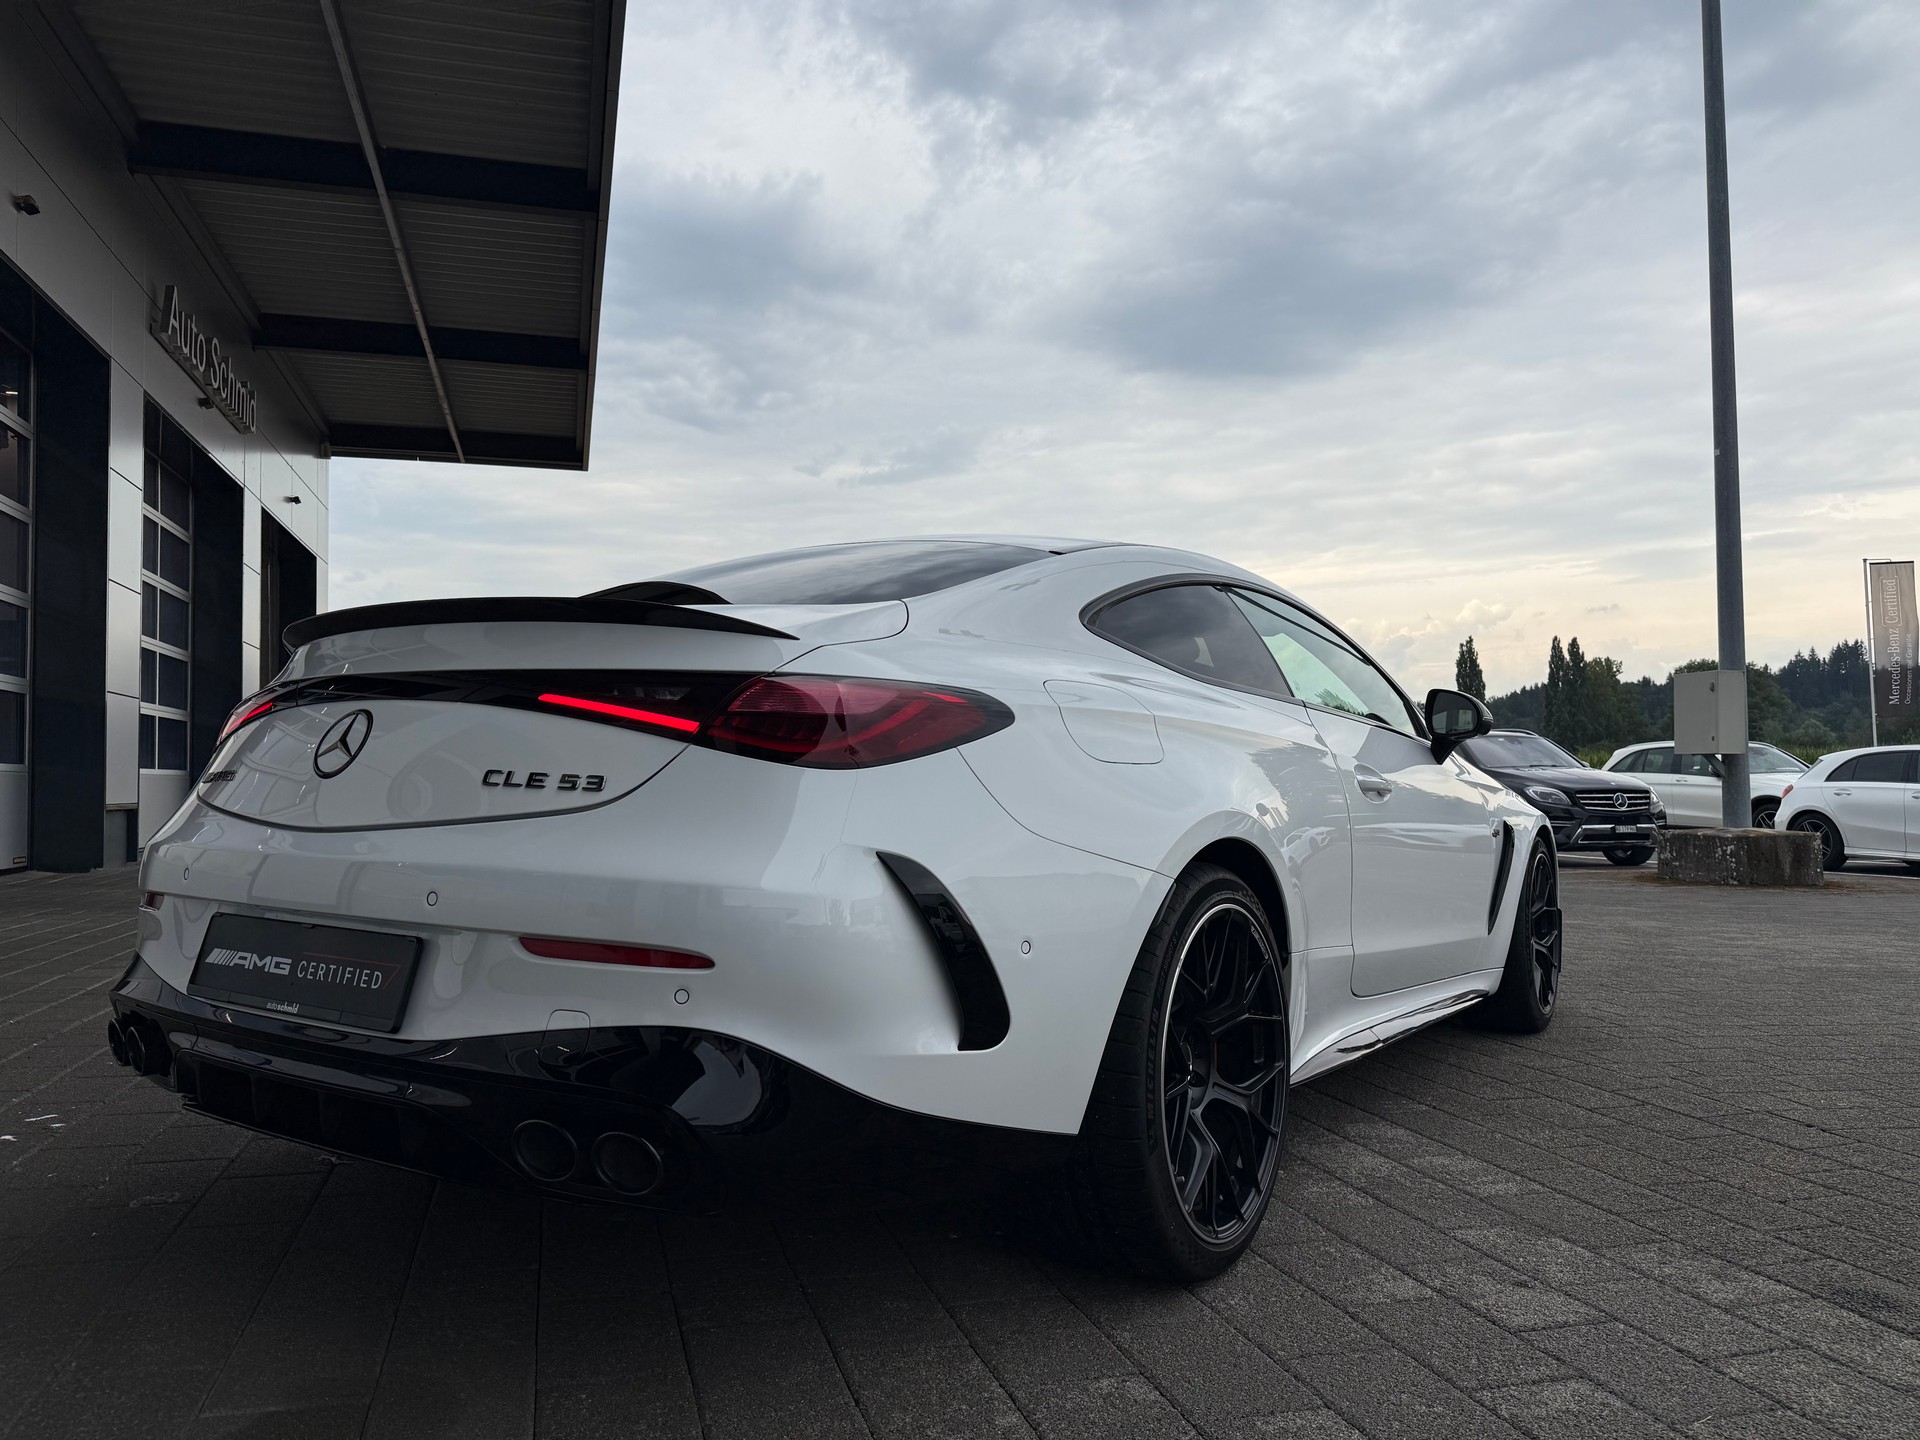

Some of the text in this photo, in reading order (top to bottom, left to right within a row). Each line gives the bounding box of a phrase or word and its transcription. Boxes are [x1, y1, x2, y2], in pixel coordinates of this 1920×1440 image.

[168, 285, 257, 434] Auto Schmid
[1882, 579, 1900, 705] Mercedes-Benz Certified
[481, 769, 607, 792] CLE 53
[297, 960, 383, 989] CERTIFIED
